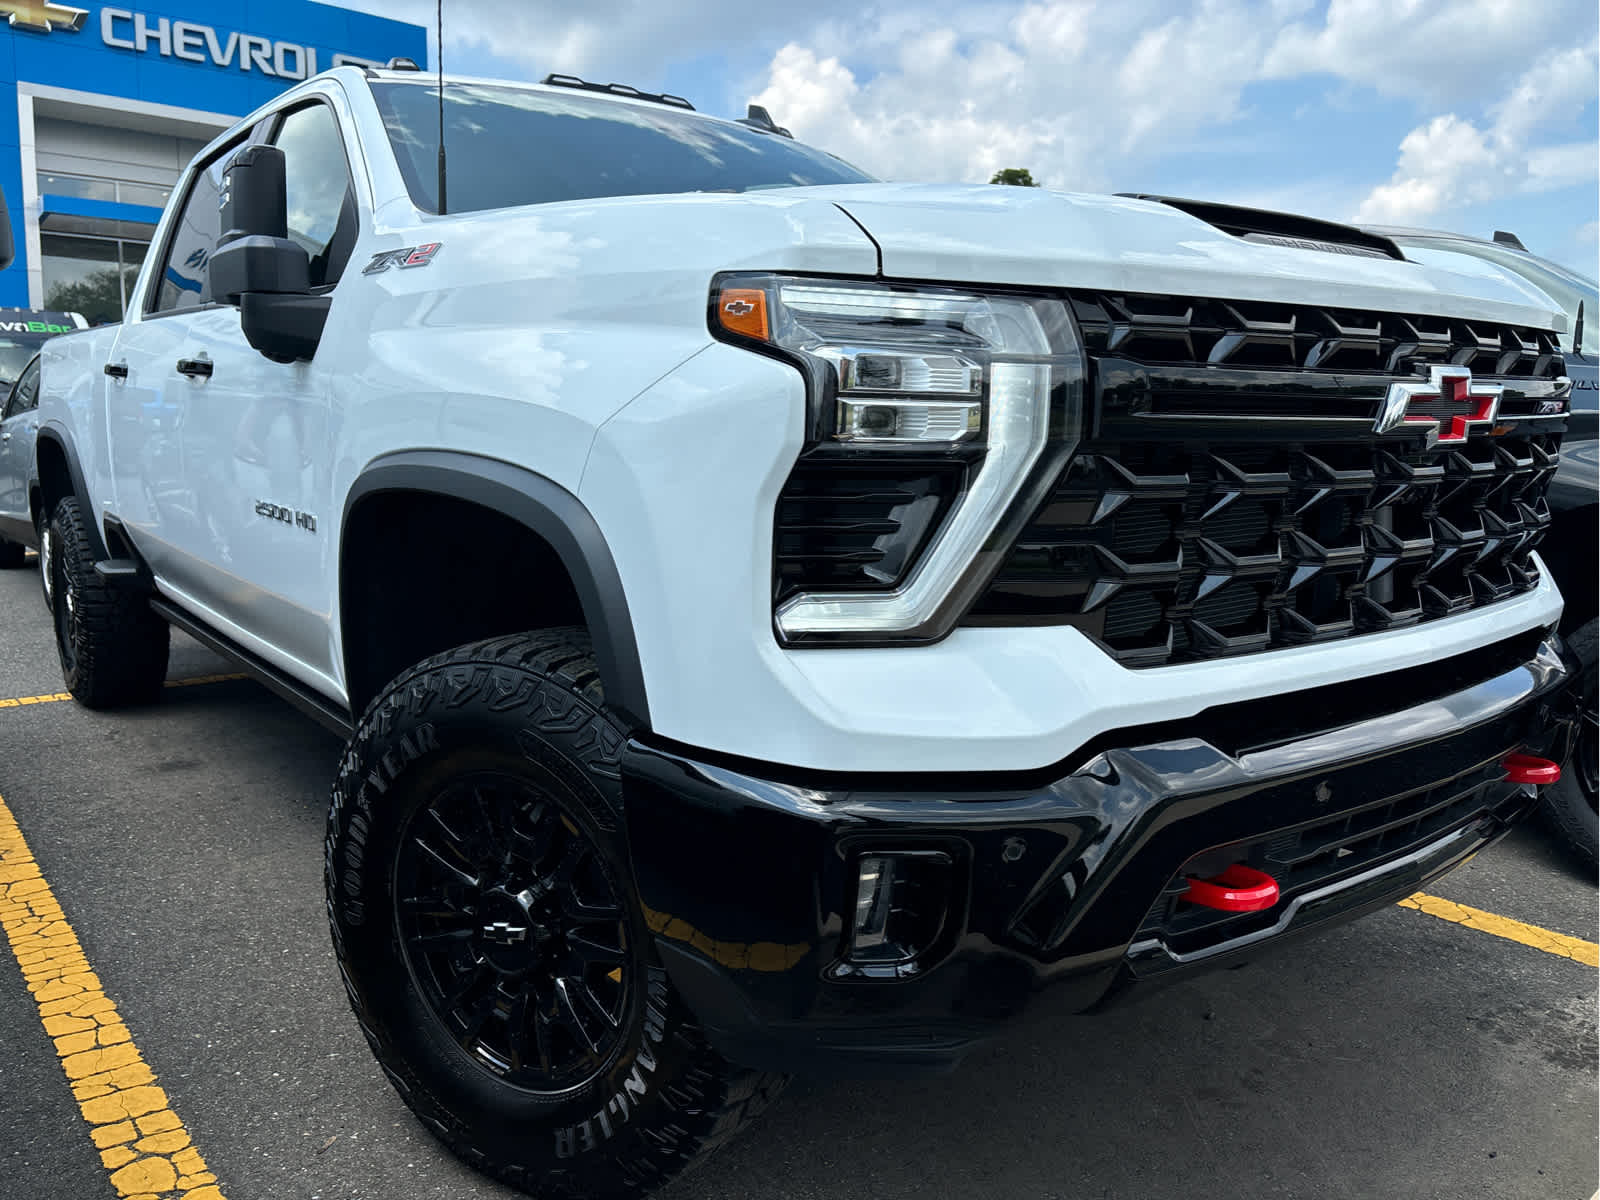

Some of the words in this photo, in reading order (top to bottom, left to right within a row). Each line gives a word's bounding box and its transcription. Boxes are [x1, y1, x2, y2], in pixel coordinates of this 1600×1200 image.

[101, 6, 388, 80] CHEVROL
[361, 242, 442, 276] ZR2
[0, 320, 72, 333] vaBar
[255, 499, 292, 524] 2500
[295, 511, 317, 532] HD
